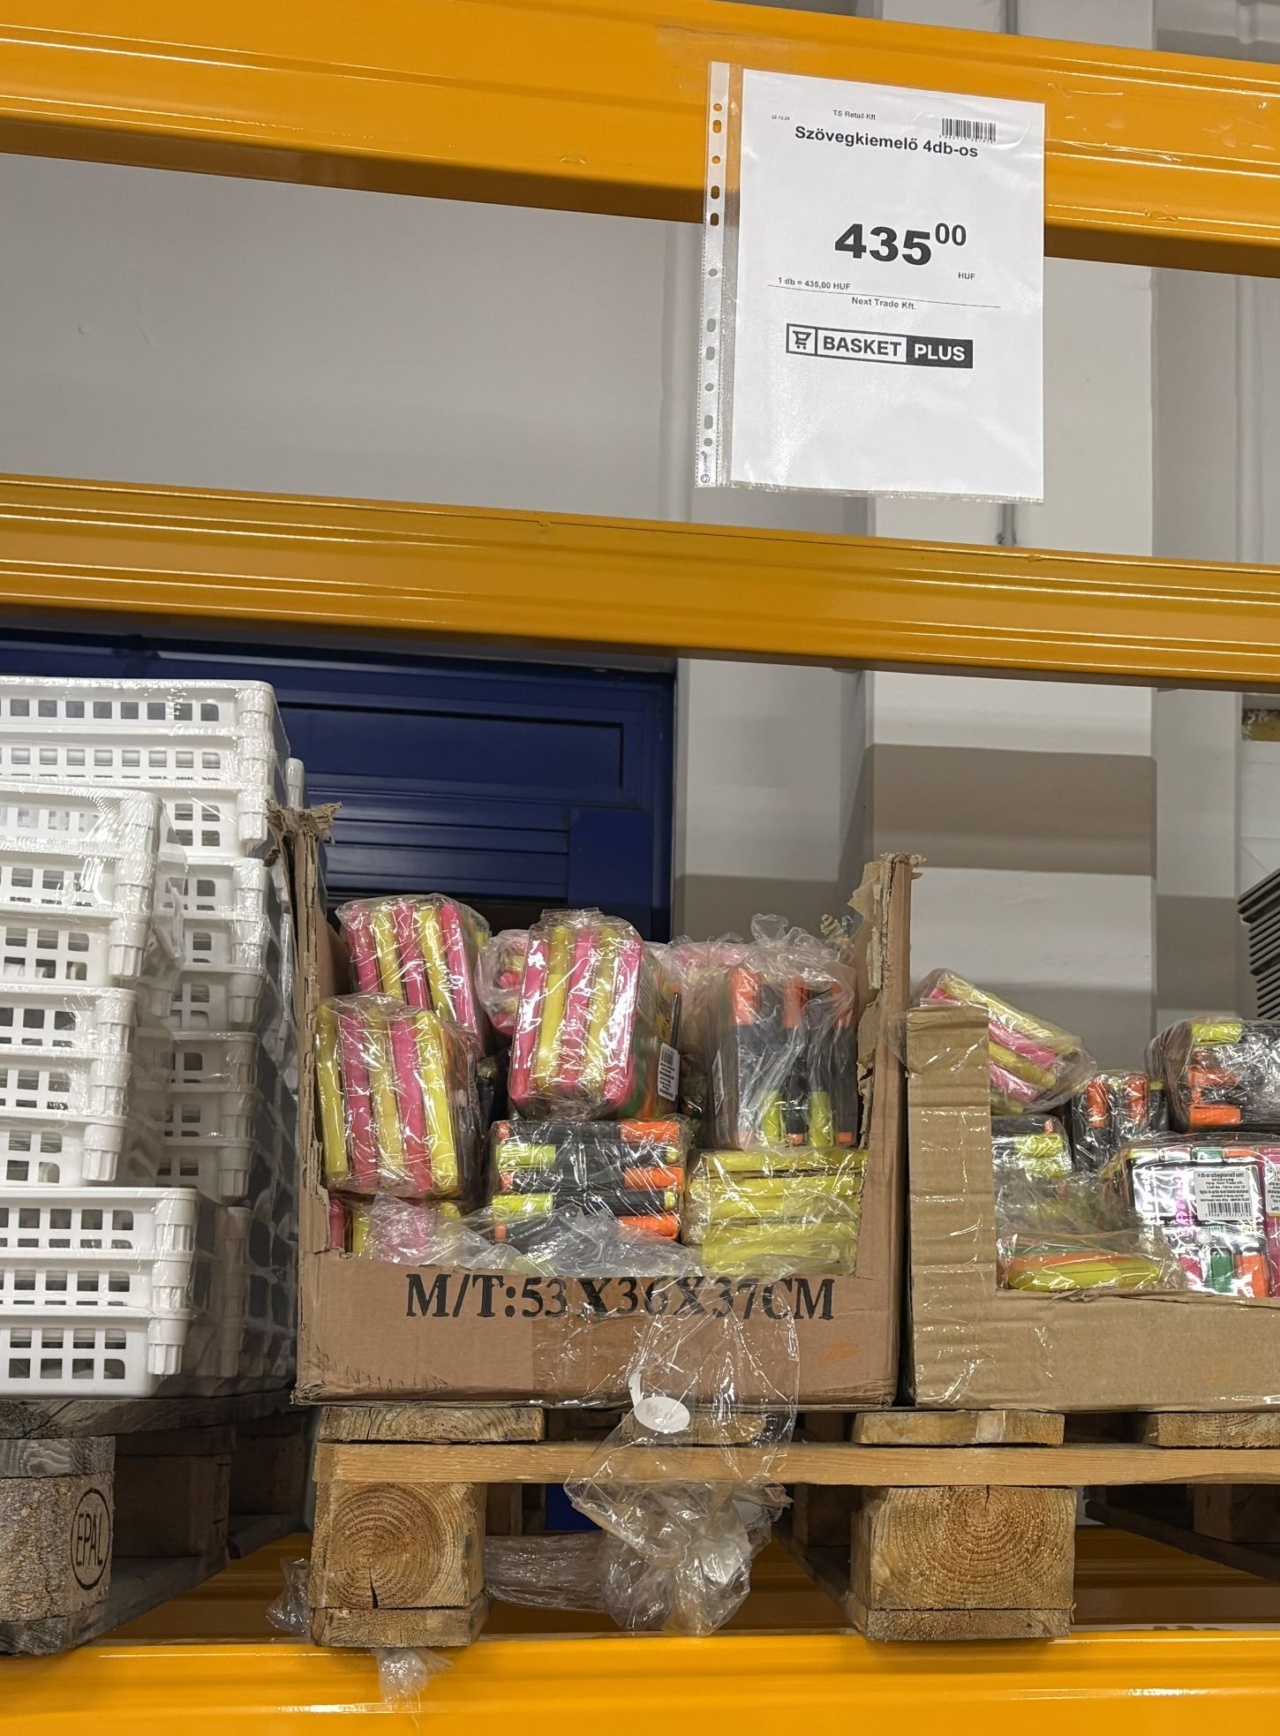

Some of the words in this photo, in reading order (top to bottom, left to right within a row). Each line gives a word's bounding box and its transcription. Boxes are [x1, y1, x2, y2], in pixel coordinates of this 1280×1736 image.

[833, 109, 843, 117] TS
[845, 111, 864, 119] Retail
[795, 125, 918, 150] Szövegkiemelő
[923, 140, 978, 157] 4db-os
[835, 223, 932, 266] 435
[935, 222, 967, 246] 00
[785, 278, 796, 286] db
[804, 279, 831, 290] 435,00
[833, 281, 851, 291] HUF
[958, 272, 976, 281] HUF
[851, 296, 872, 306] Next
[874, 298, 899, 309] Trade
[901, 301, 917, 311] Kft.
[822, 335, 902, 358] BASKET
[914, 343, 966, 362] PLUS
[76, 1512, 103, 1567] EPAL
